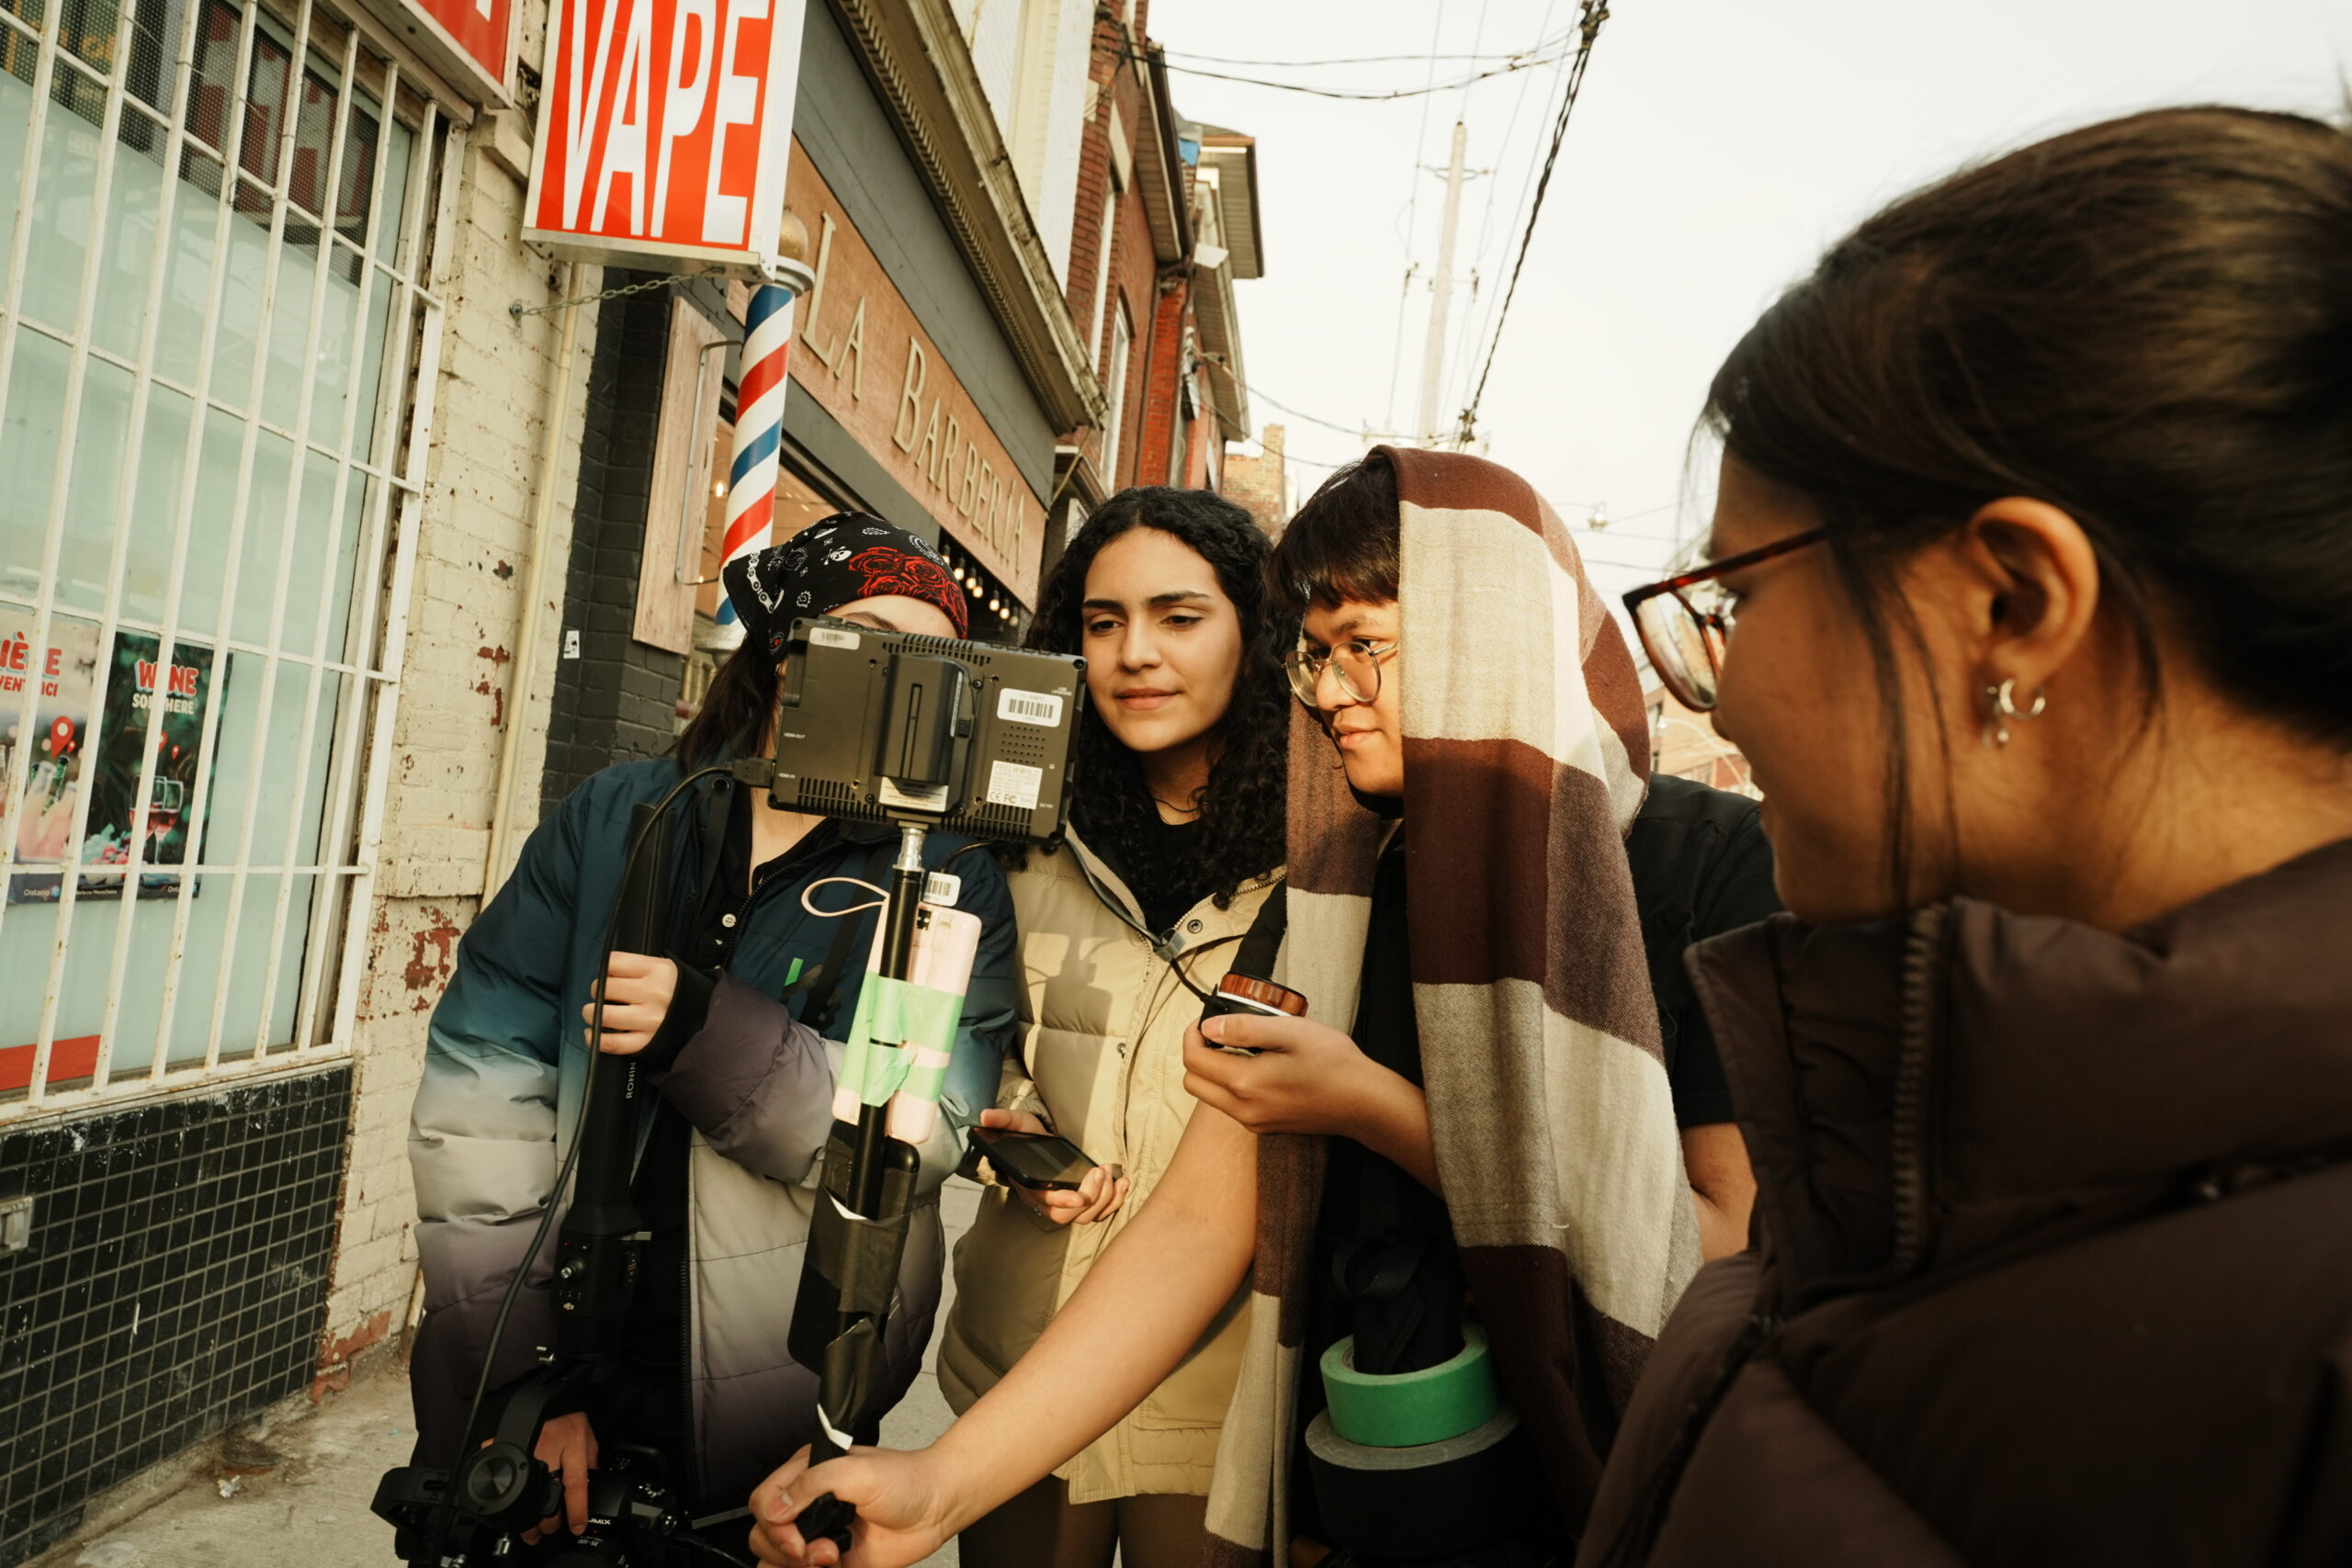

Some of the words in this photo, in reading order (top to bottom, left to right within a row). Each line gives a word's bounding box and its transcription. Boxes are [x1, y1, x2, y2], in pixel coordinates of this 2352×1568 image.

[562, 0, 769, 245] VAPE
[800, 210, 865, 402] LA
[0, 631, 62, 676] IÈE
[40, 681, 59, 697] ICI
[135, 659, 198, 696] WNE
[164, 698, 195, 716] HERE
[23, 887, 51, 897] Ontario
[625, 1061, 638, 1100] RONIN
[587, 1517, 611, 1525] UMIX
